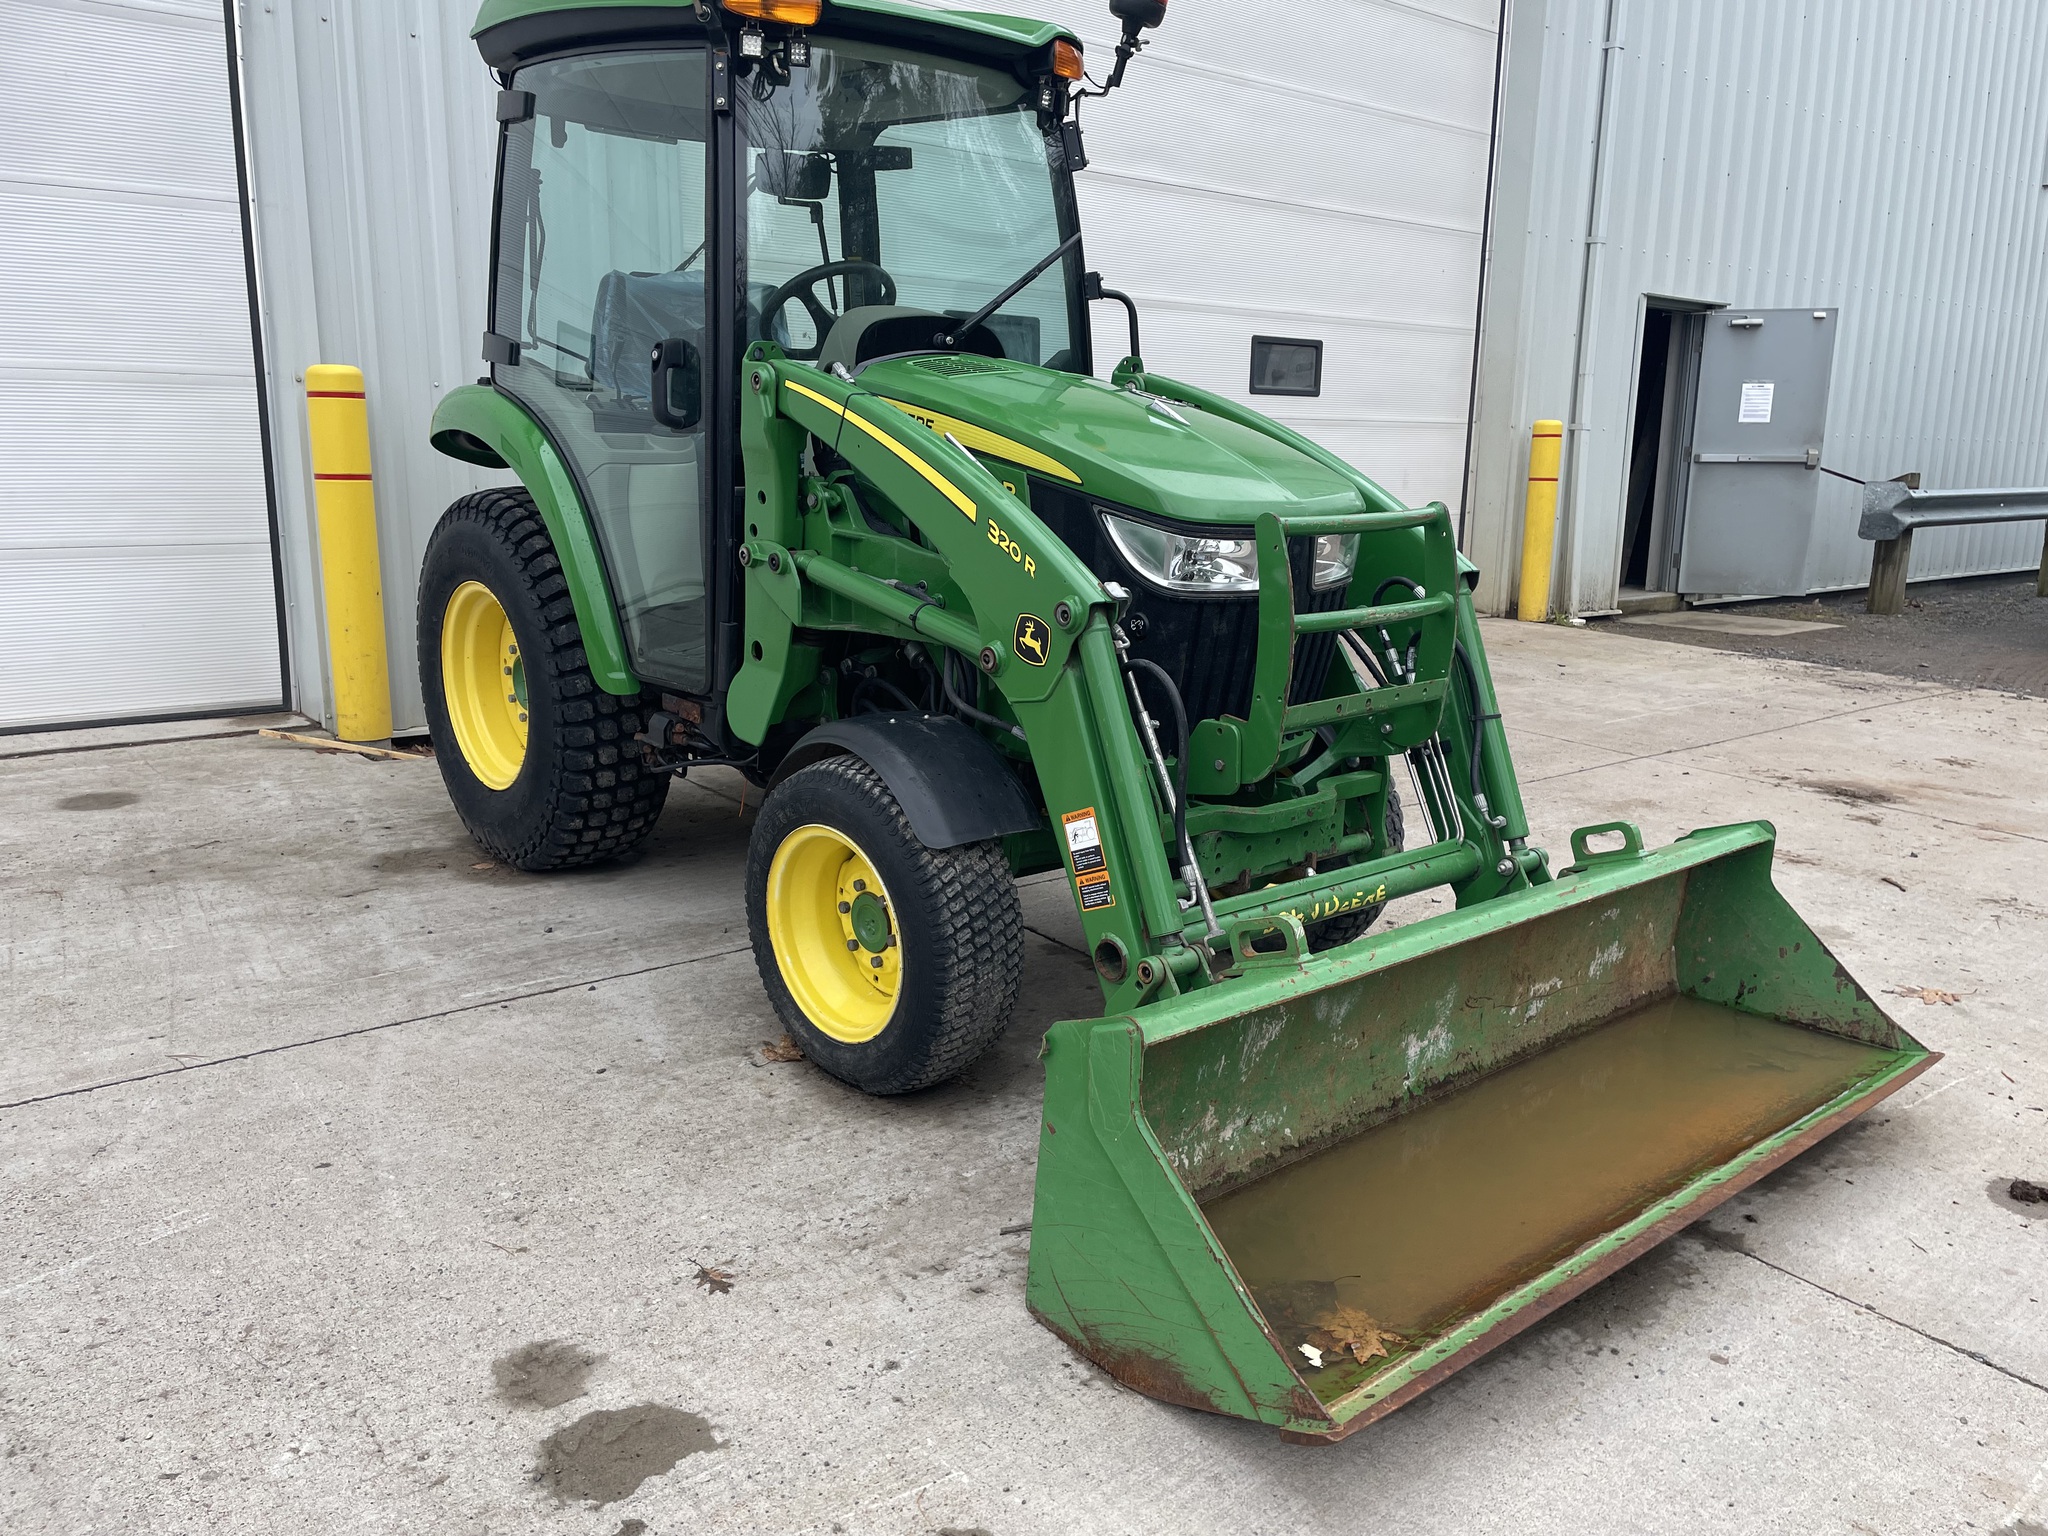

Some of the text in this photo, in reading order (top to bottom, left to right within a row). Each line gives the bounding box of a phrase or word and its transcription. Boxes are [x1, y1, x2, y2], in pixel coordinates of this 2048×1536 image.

[987, 517, 1036, 580] 320 R
[1071, 810, 1091, 820] WARNING
[1084, 873, 1106, 883] WARNING
